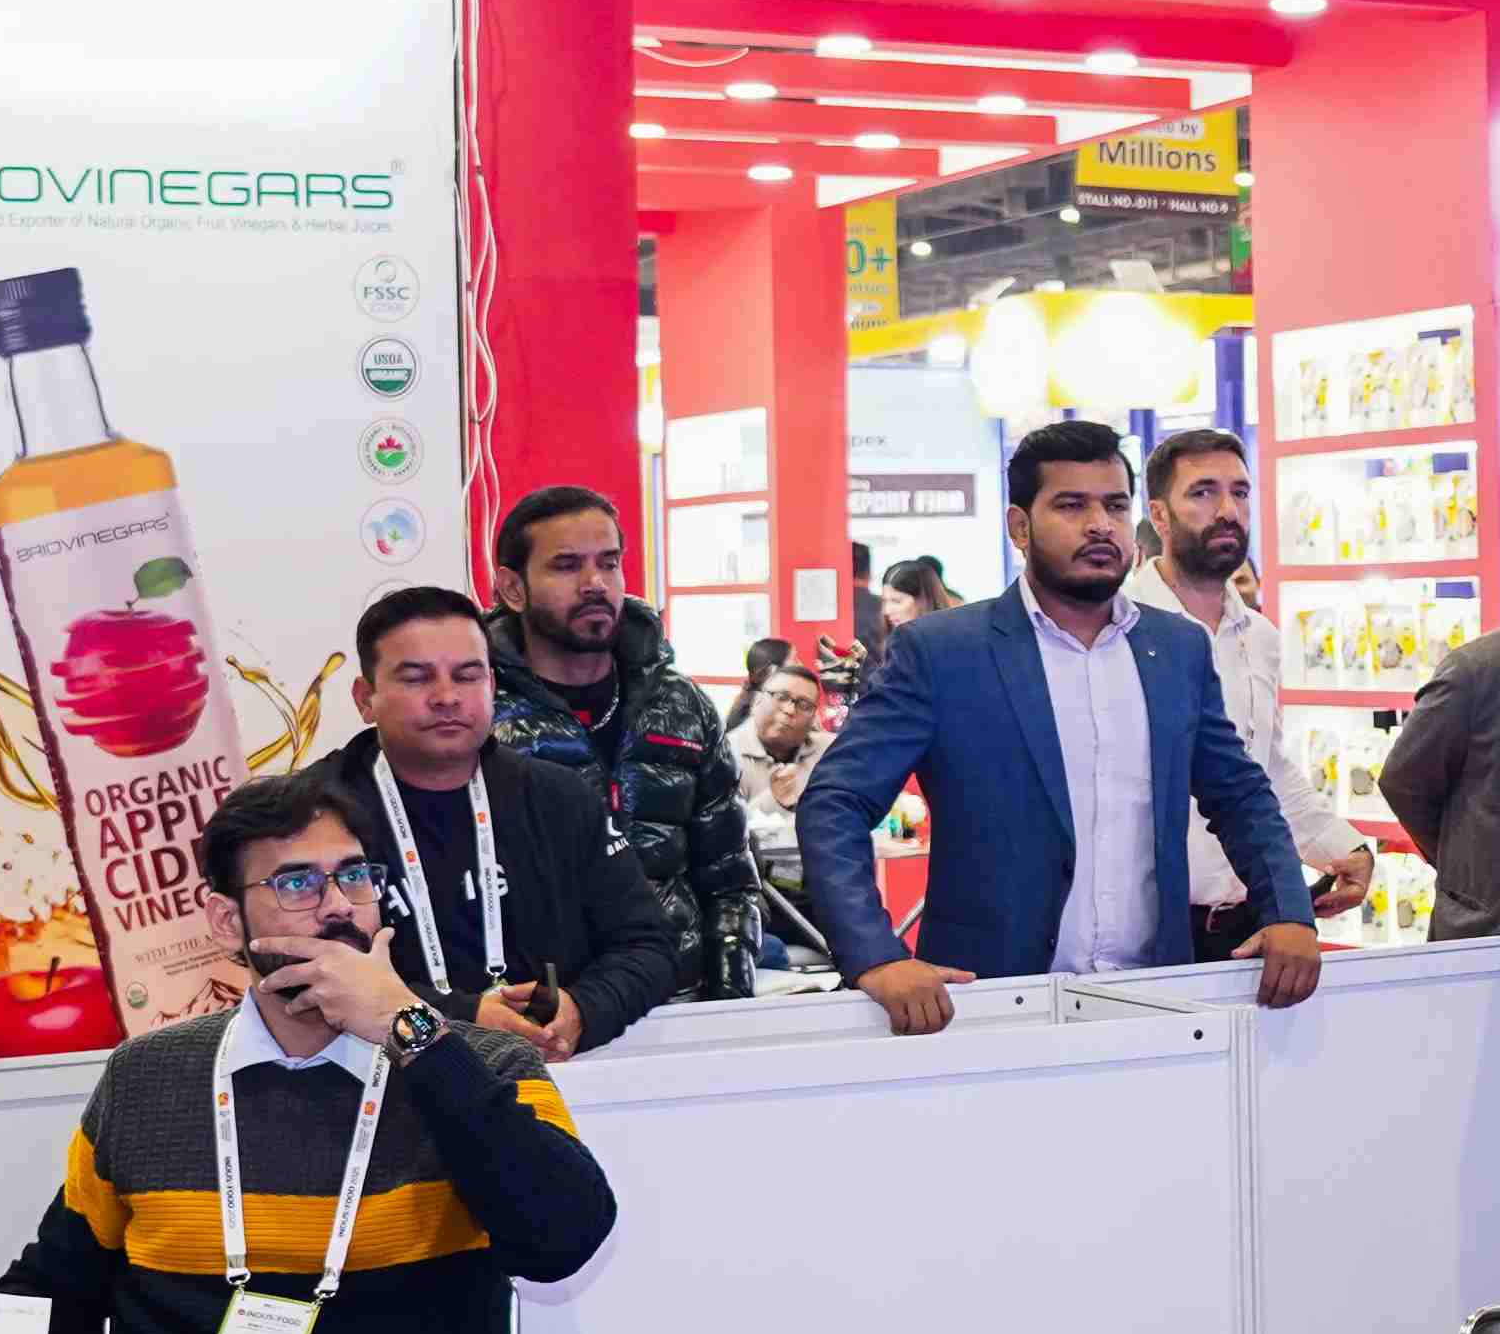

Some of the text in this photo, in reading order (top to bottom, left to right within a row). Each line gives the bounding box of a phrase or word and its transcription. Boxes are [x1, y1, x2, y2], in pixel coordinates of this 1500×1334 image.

[1099, 140, 1217, 172] Millions
[363, 286, 410, 300] FSSC
[16, 515, 171, 562] BRIOVINEGARS
[84, 755, 232, 817] ORGANIC
[104, 836, 208, 901] CID
[113, 881, 213, 933] VINEG
